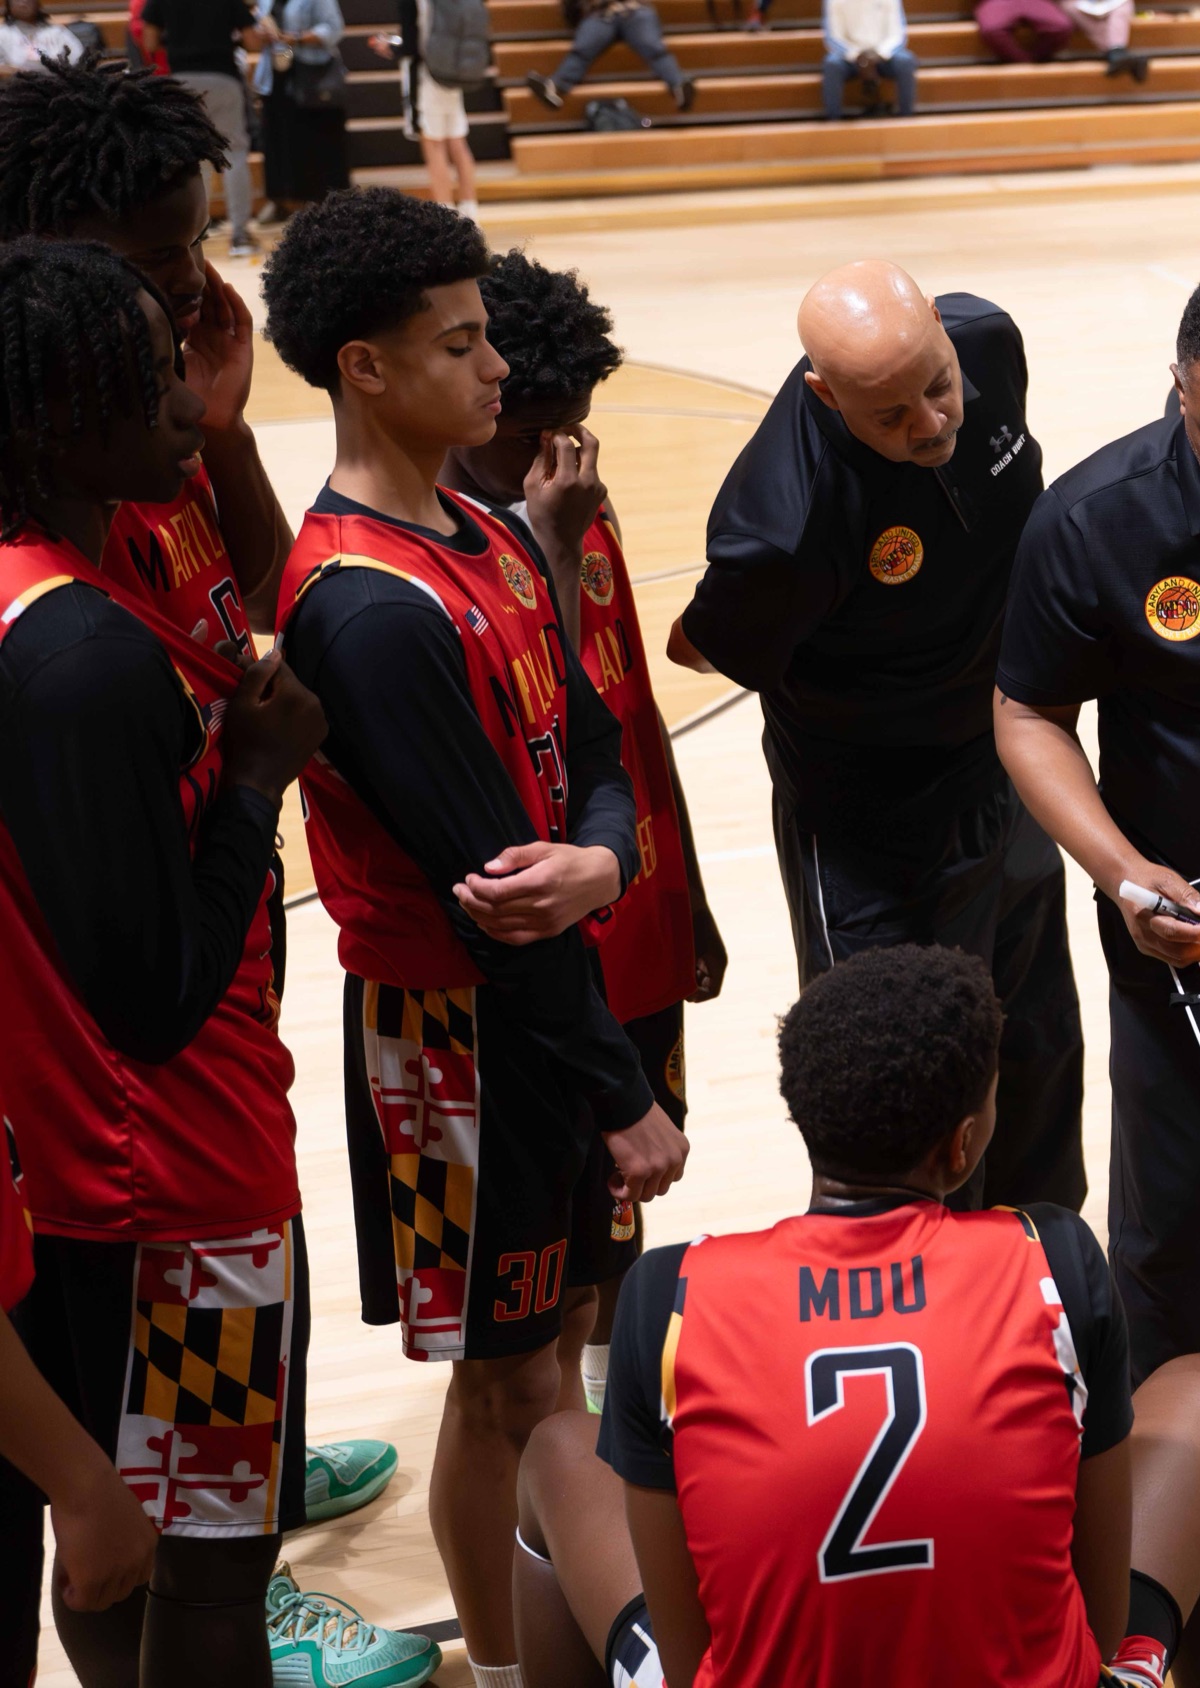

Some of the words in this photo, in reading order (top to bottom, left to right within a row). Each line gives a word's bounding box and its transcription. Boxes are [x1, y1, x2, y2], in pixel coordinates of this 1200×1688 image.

[990, 451, 1013, 477] COACH
[127, 500, 226, 593] MARYL
[1147, 578, 1185, 618] MARYLAND
[594, 618, 633, 695] AND
[493, 1238, 568, 1322] 30
[799, 1254, 927, 1323] MDU
[804, 1341, 935, 1584] 2
